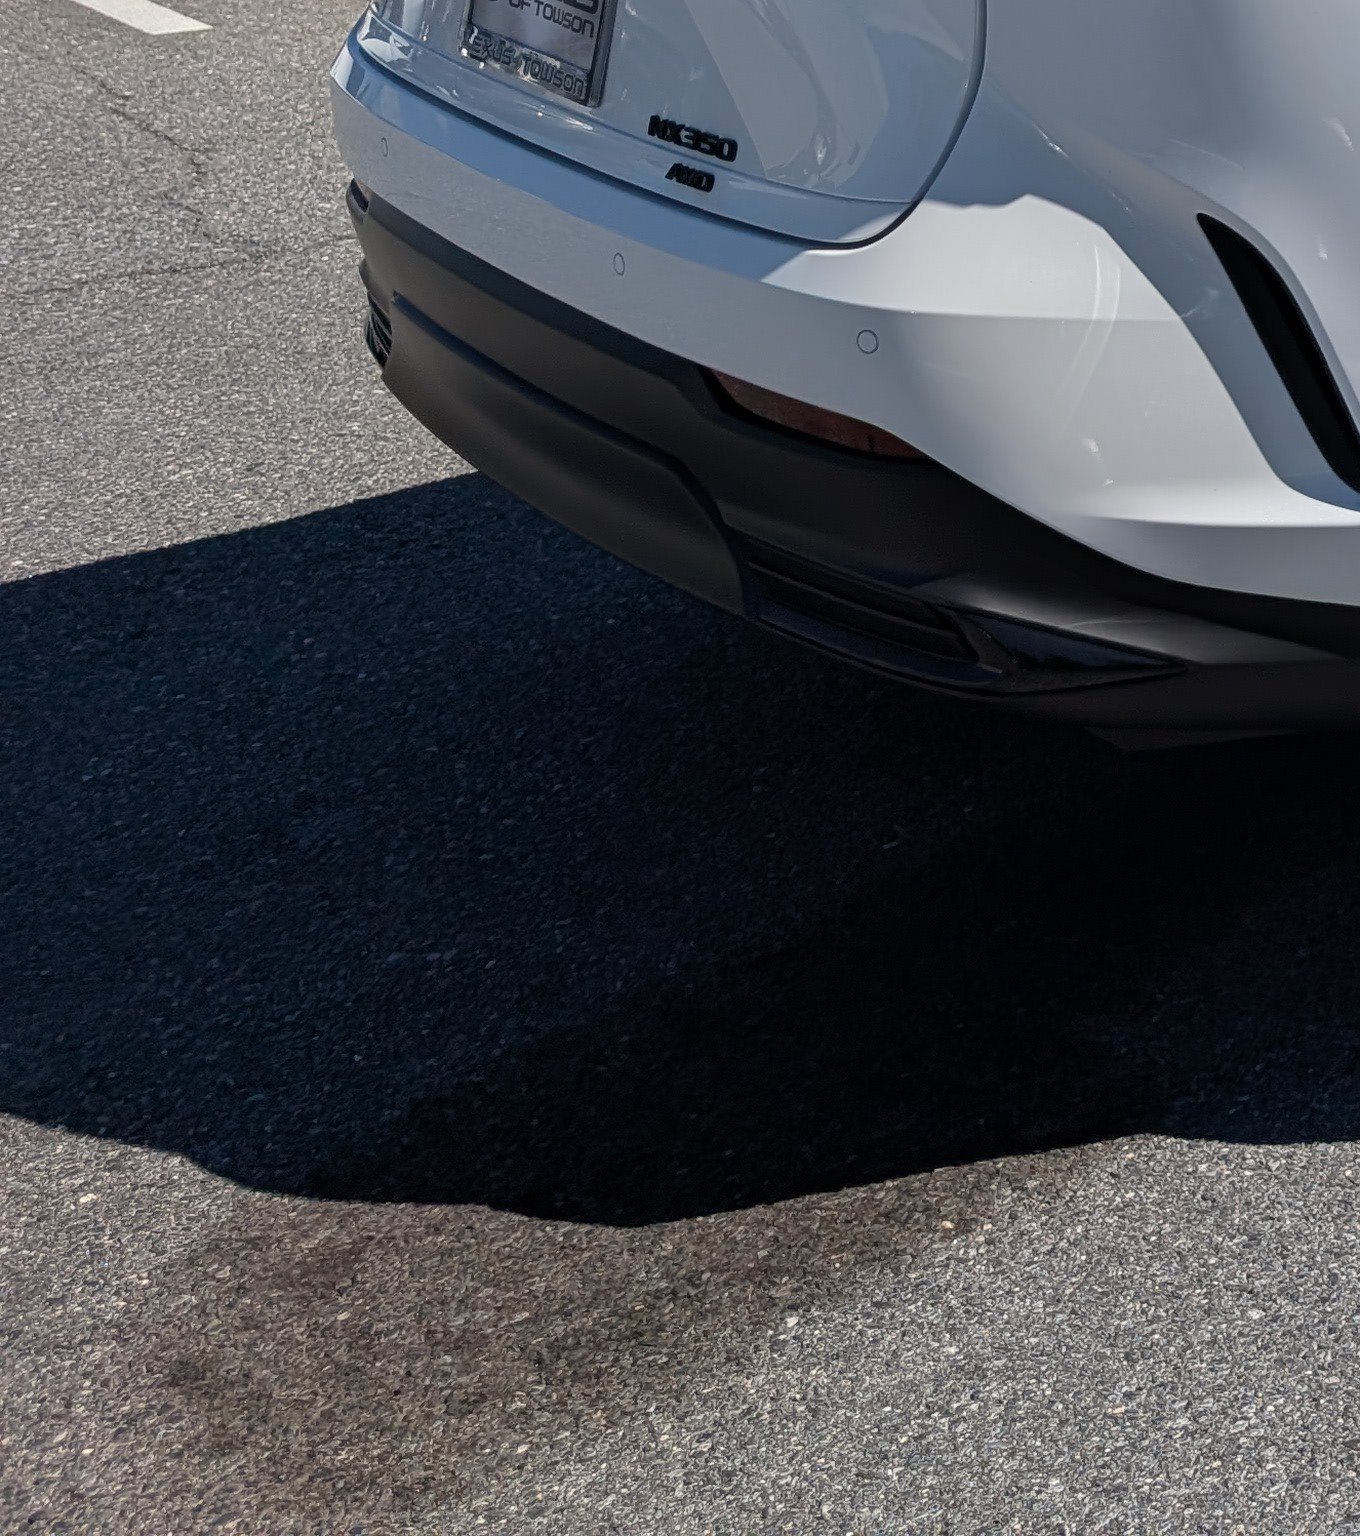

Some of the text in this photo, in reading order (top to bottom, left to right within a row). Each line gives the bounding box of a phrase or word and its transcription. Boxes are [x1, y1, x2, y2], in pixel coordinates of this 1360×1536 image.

[534, 0, 595, 38] TOWSON
[522, 52, 587, 98] TOWSON
[648, 115, 738, 162] NX350
[665, 163, 715, 193] AWD
